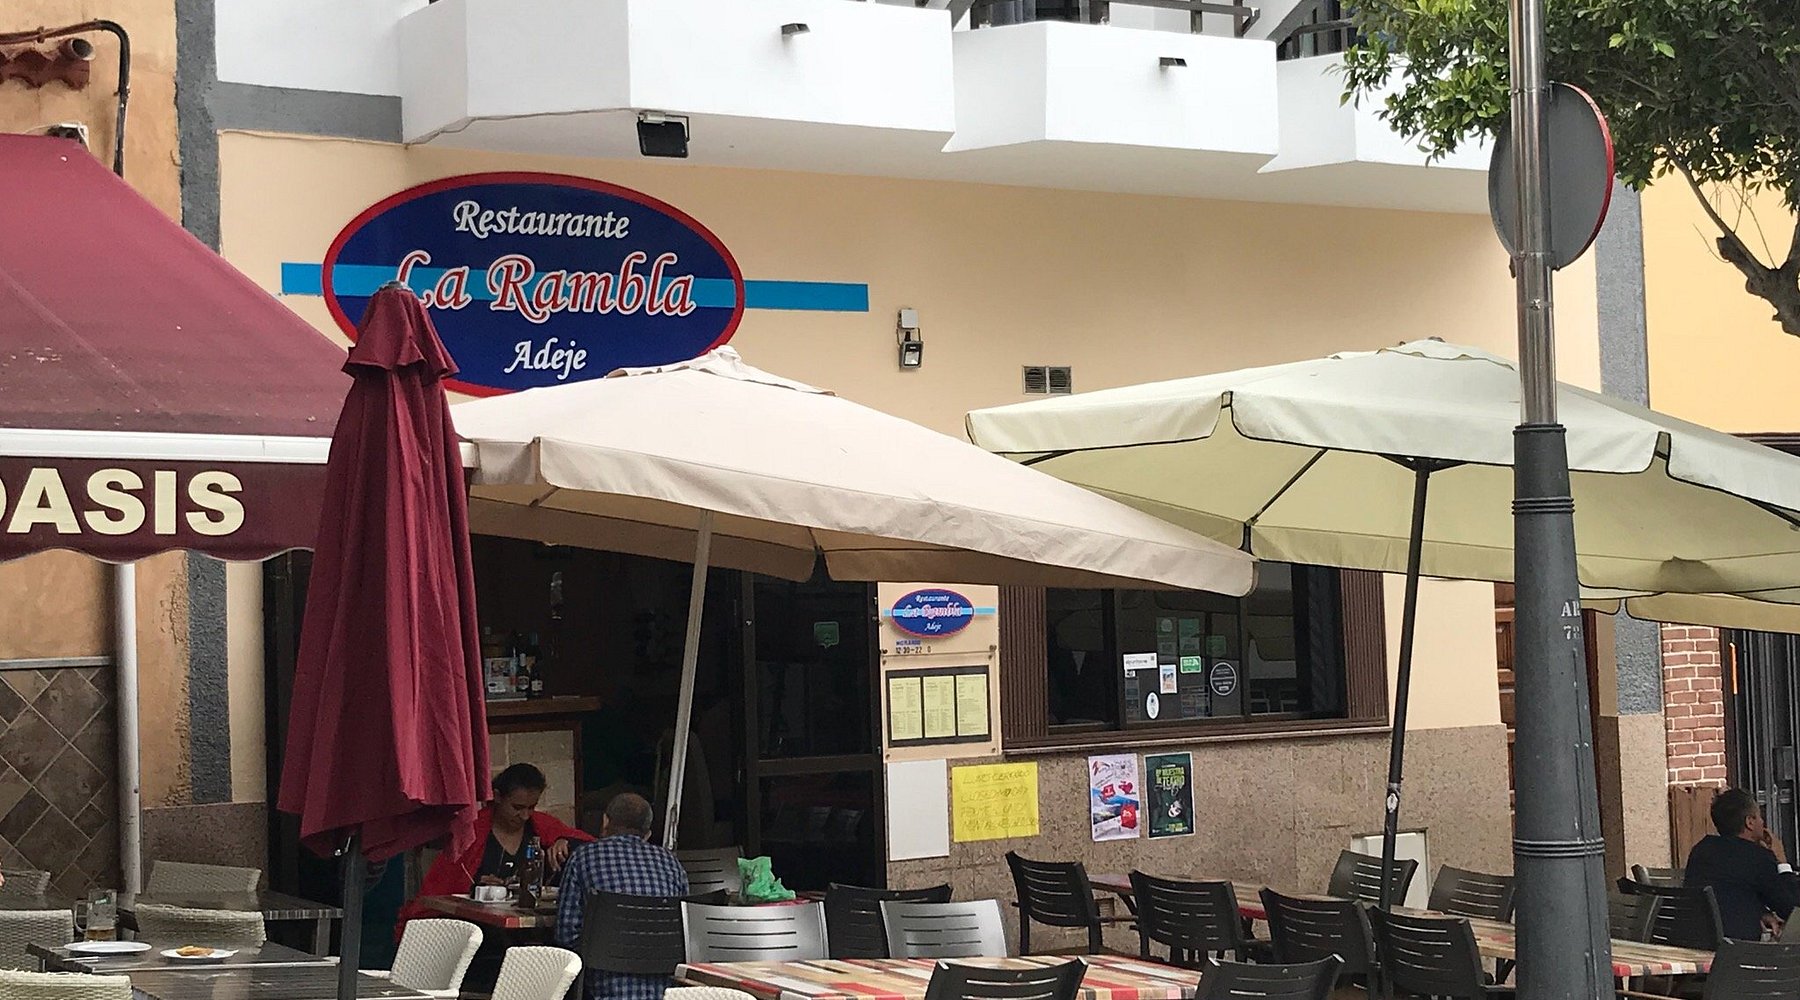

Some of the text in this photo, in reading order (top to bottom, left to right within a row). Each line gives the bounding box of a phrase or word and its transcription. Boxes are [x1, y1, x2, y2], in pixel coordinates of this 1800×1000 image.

[453, 200, 630, 240] Restaurante
[396, 249, 697, 324] La Rambla
[503, 337, 587, 380] Adeje
[0, 467, 245, 536] ASIS
